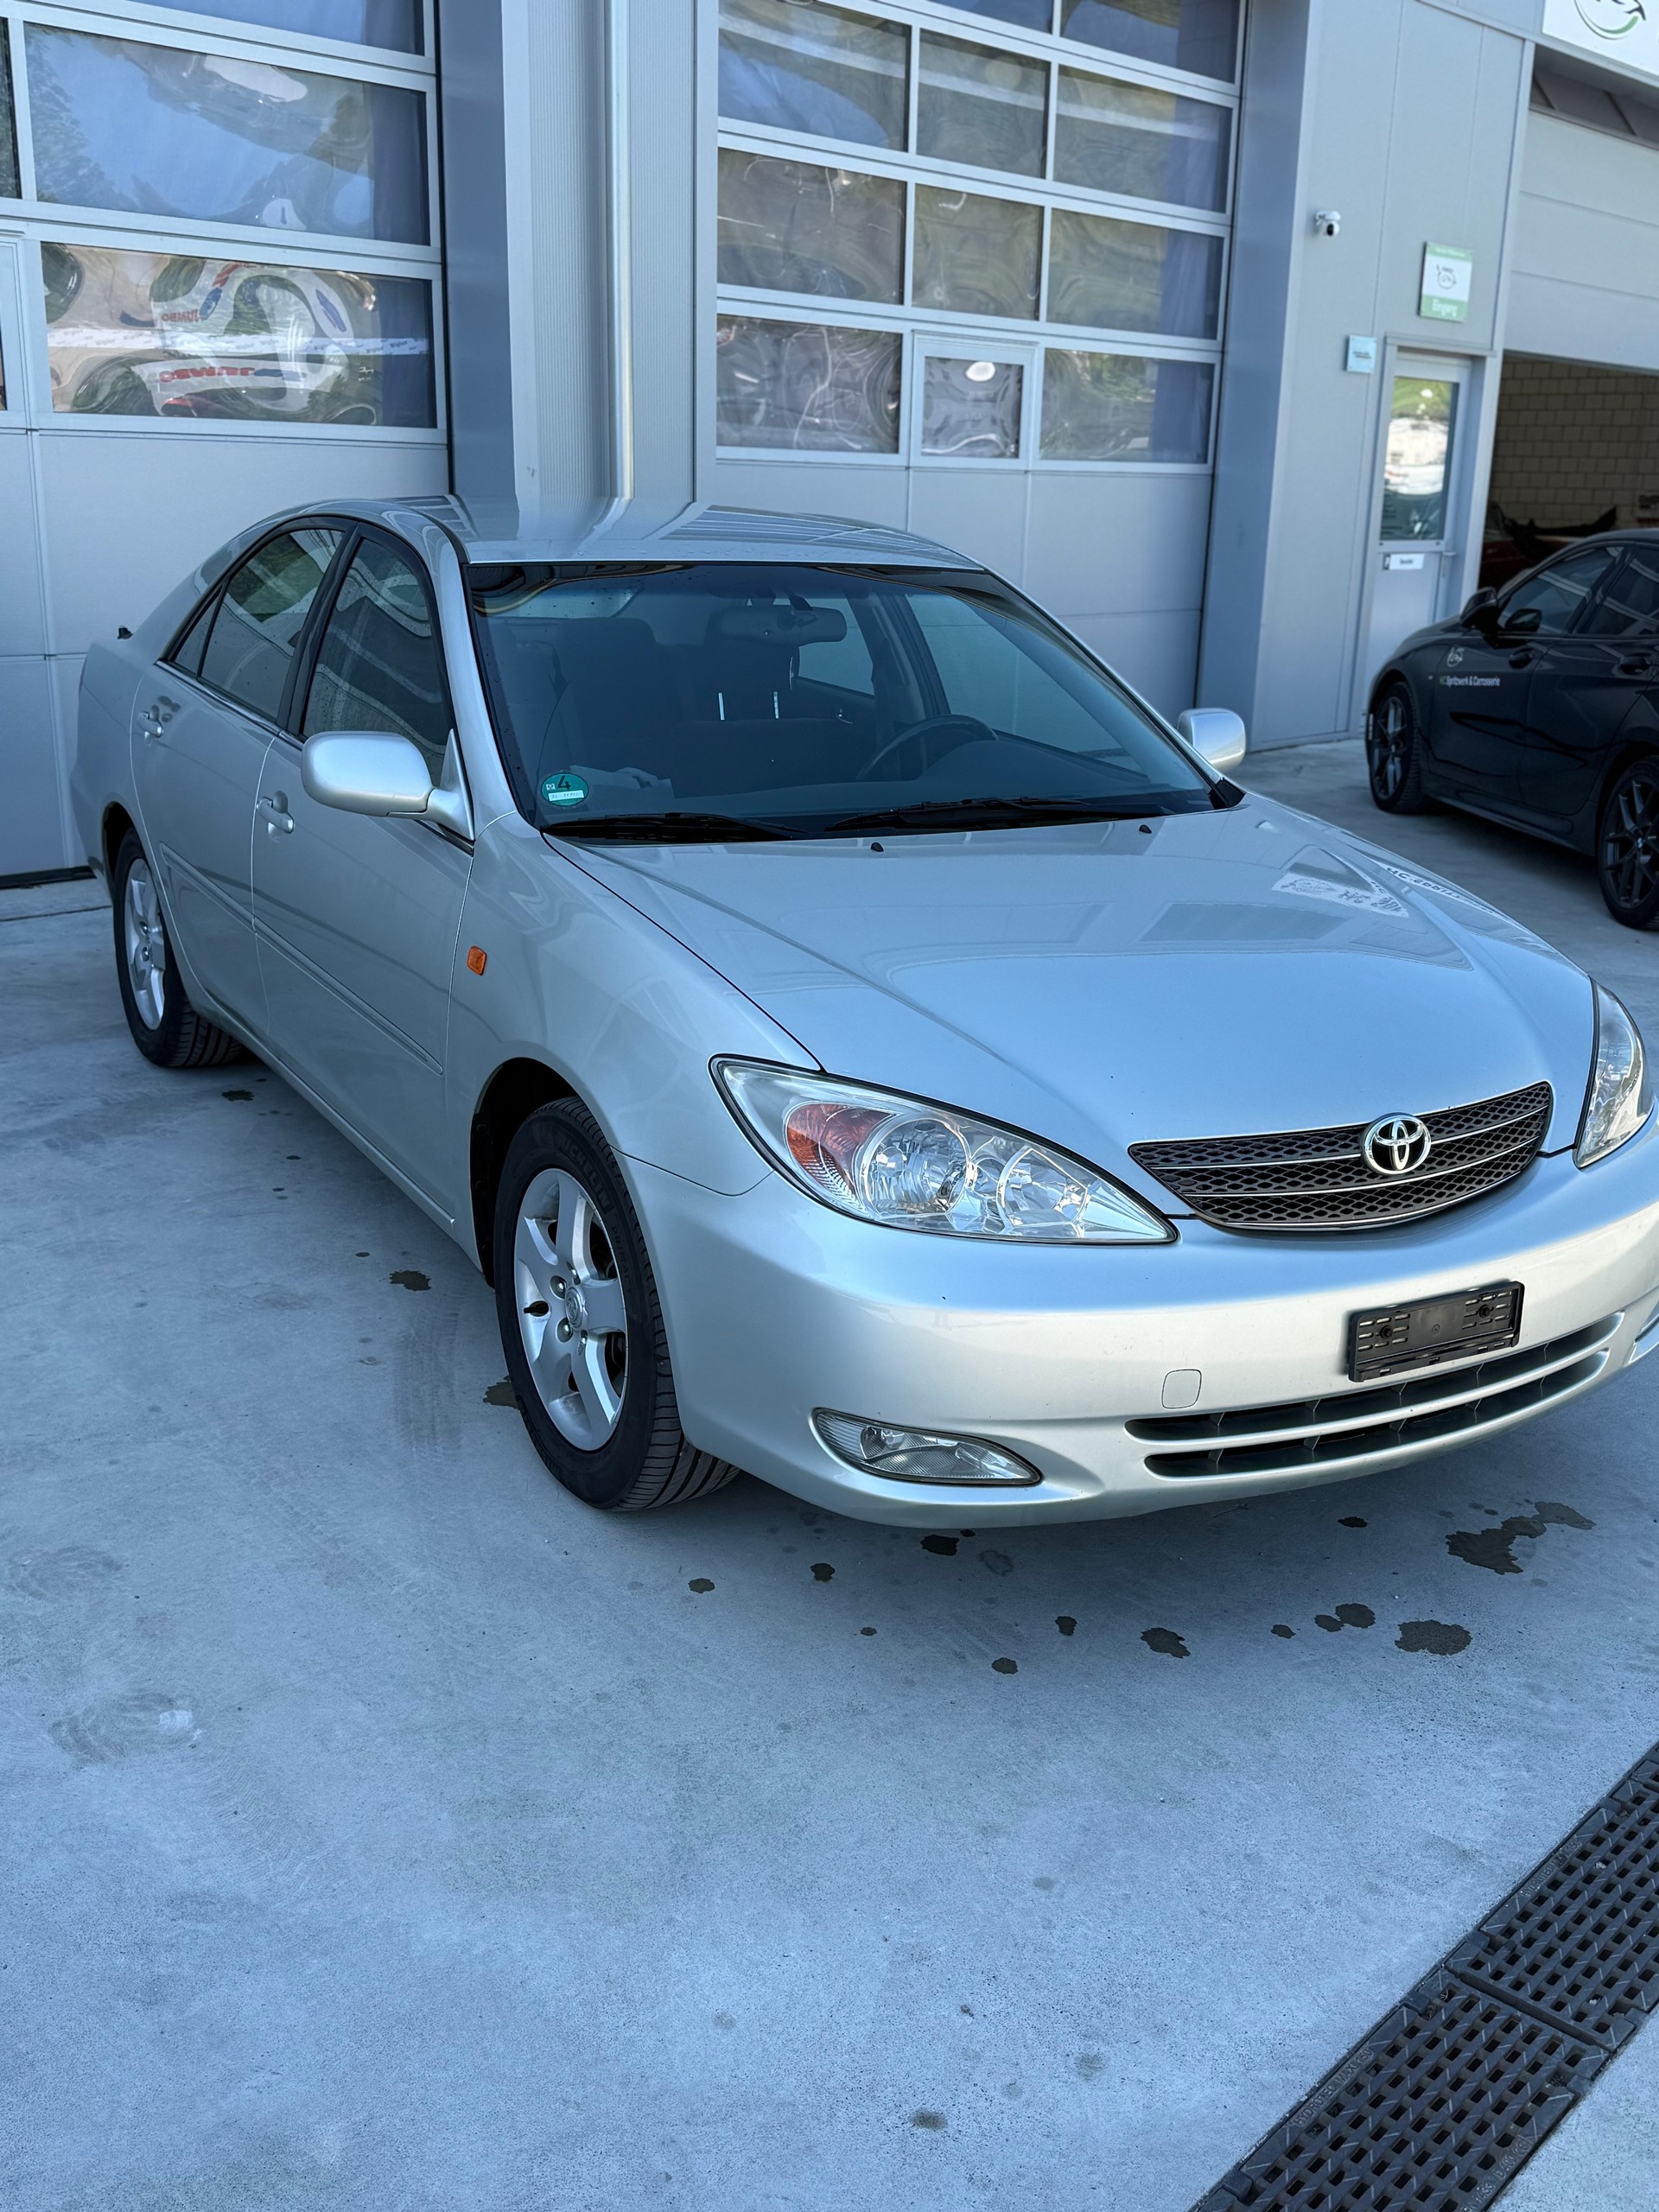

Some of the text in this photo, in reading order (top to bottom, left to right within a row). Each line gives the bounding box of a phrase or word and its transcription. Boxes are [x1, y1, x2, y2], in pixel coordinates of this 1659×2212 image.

[1446, 676, 1469, 688] Spritzwerk
[1473, 676, 1501, 686] Carrosserie
[557, 774, 572, 790] 4
[554, 1130, 615, 1211] MICHELIN
[612, 1226, 634, 1294] PRIMACY
[1294, 2083, 1338, 2126] HYDROTEC
[1357, 2047, 1374, 2065] 150
